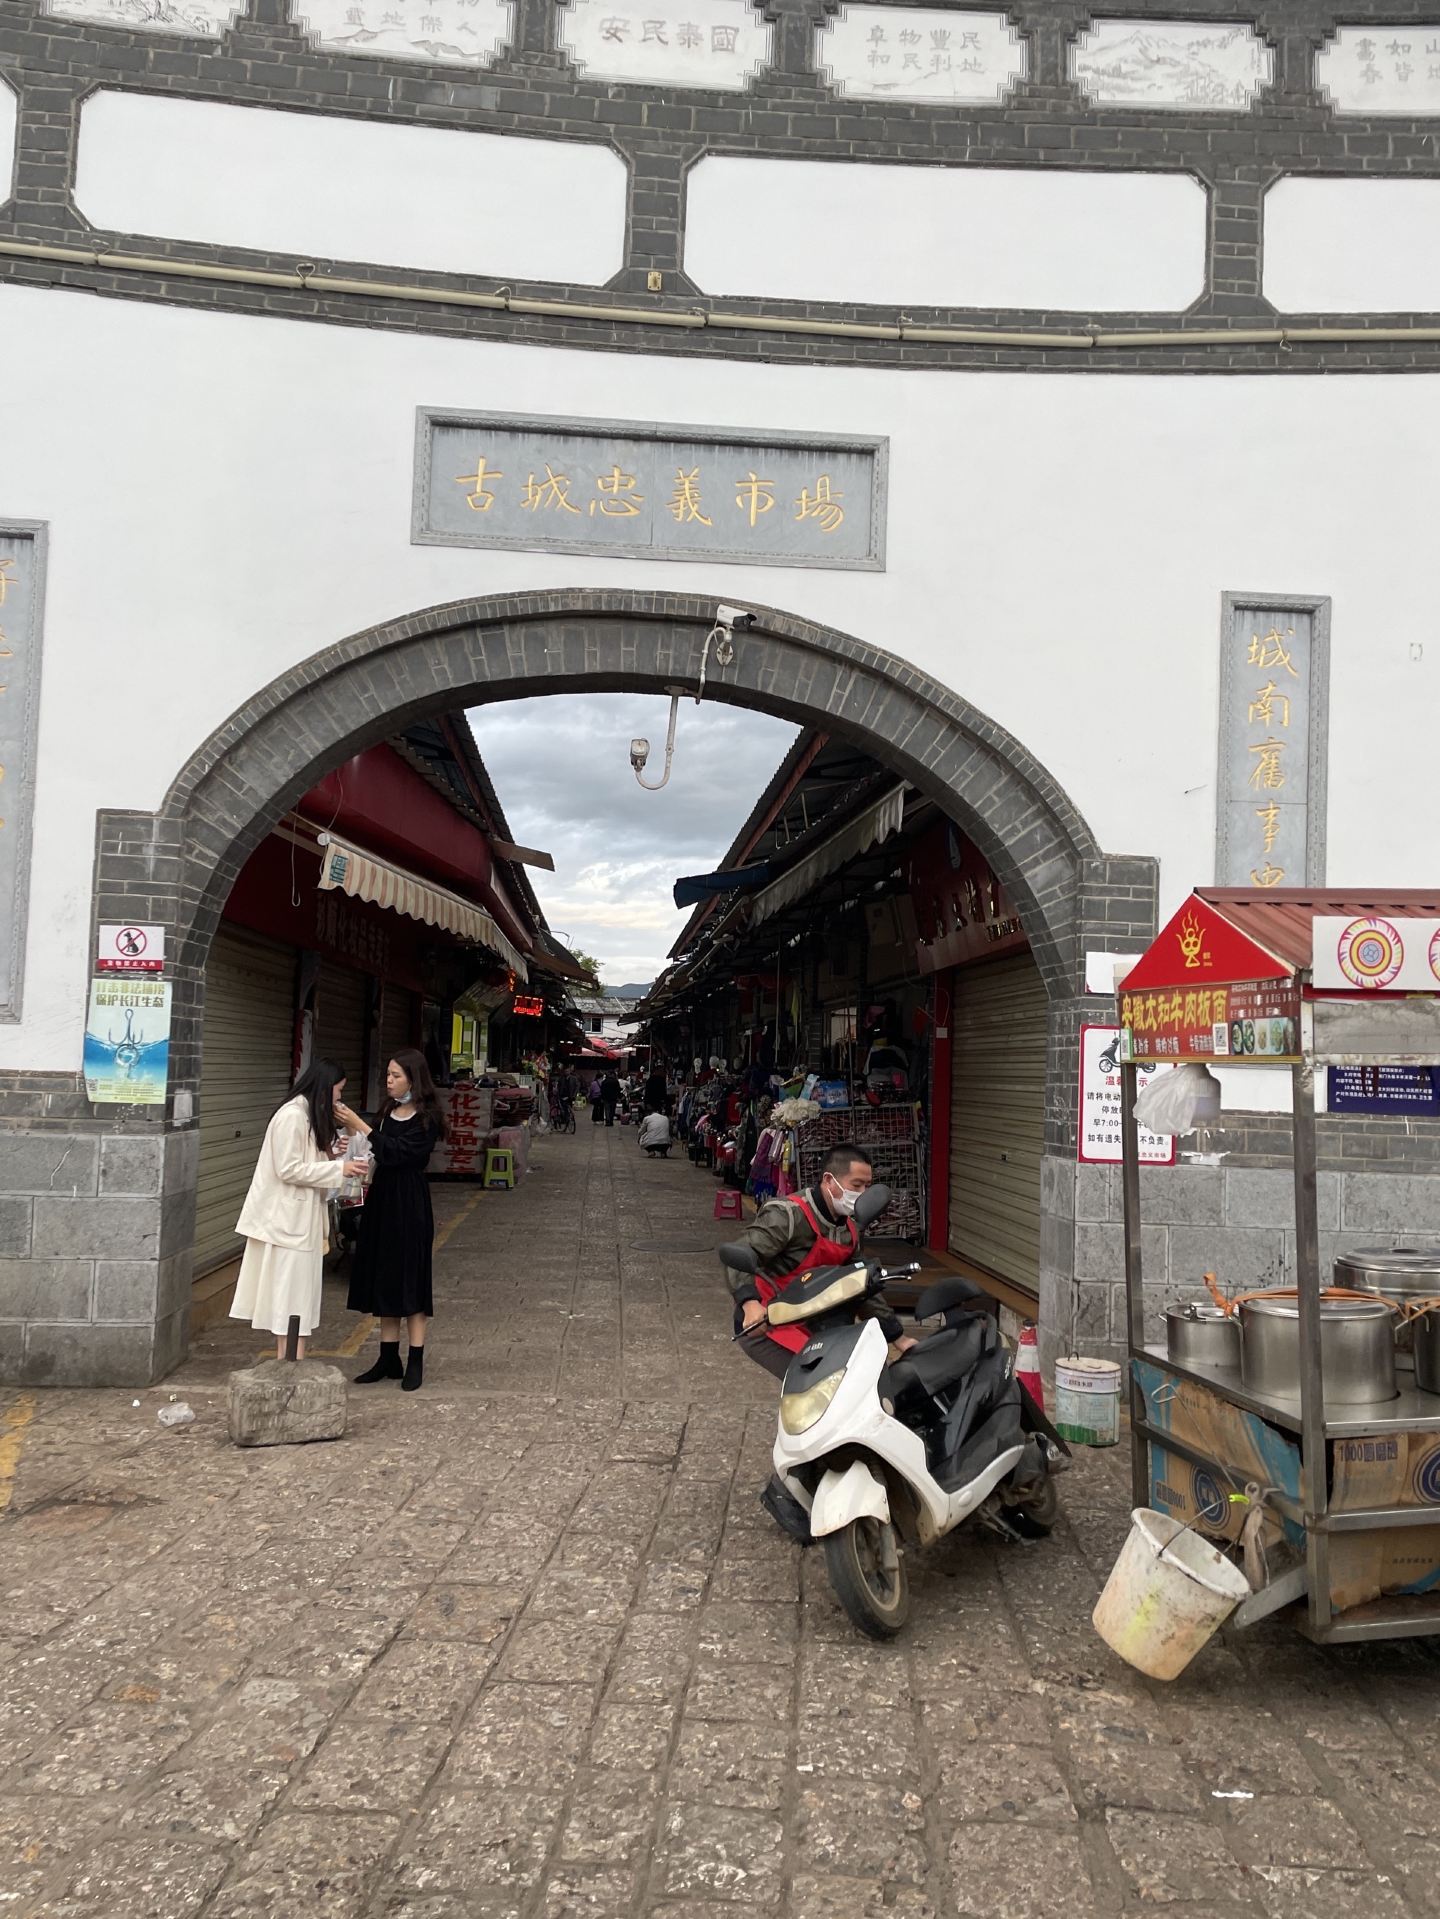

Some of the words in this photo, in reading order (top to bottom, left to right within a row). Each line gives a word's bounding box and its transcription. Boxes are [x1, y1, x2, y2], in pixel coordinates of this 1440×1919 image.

[455, 456, 846, 532] 古城忠義市場
[96, 994, 164, 1008] 保护长江生态
[1087, 1091, 1122, 1101] 请将电动
